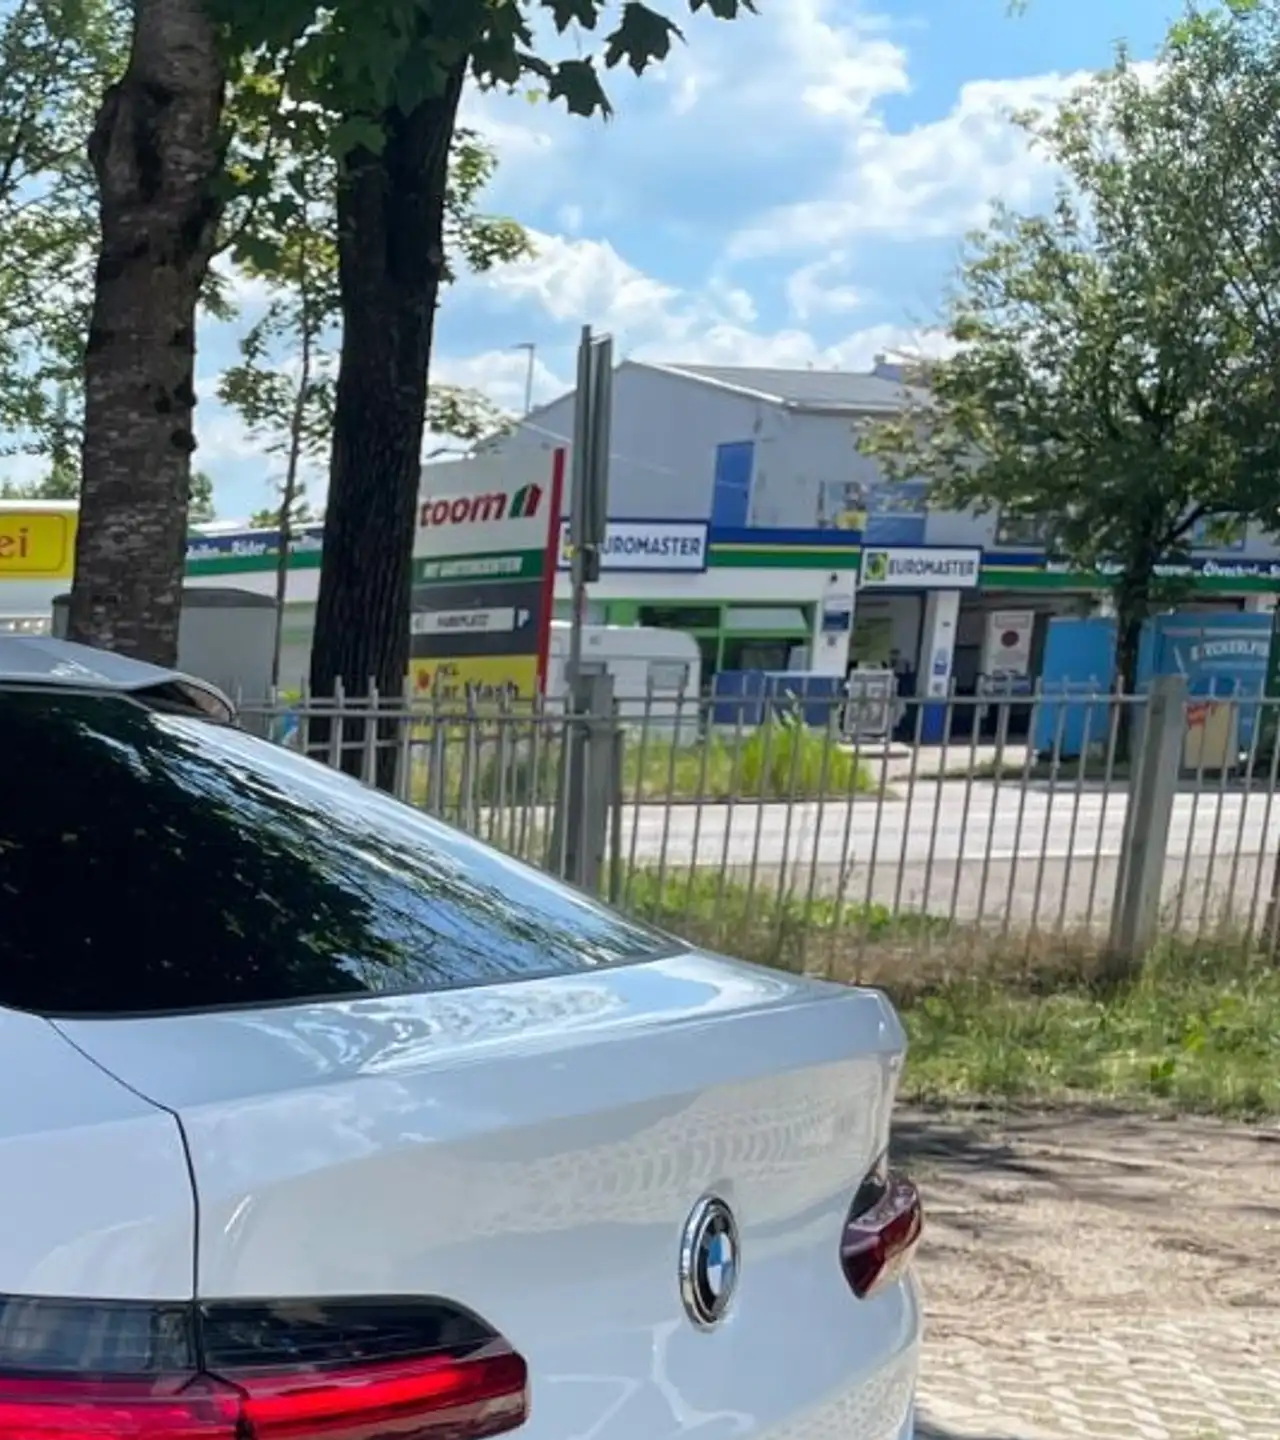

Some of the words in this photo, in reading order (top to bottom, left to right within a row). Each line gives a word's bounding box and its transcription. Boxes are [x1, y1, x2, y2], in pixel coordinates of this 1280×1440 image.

[421, 493, 507, 527] toom
[603, 535, 701, 556] UROMASTER
[889, 559, 974, 577] EUROMASTER
